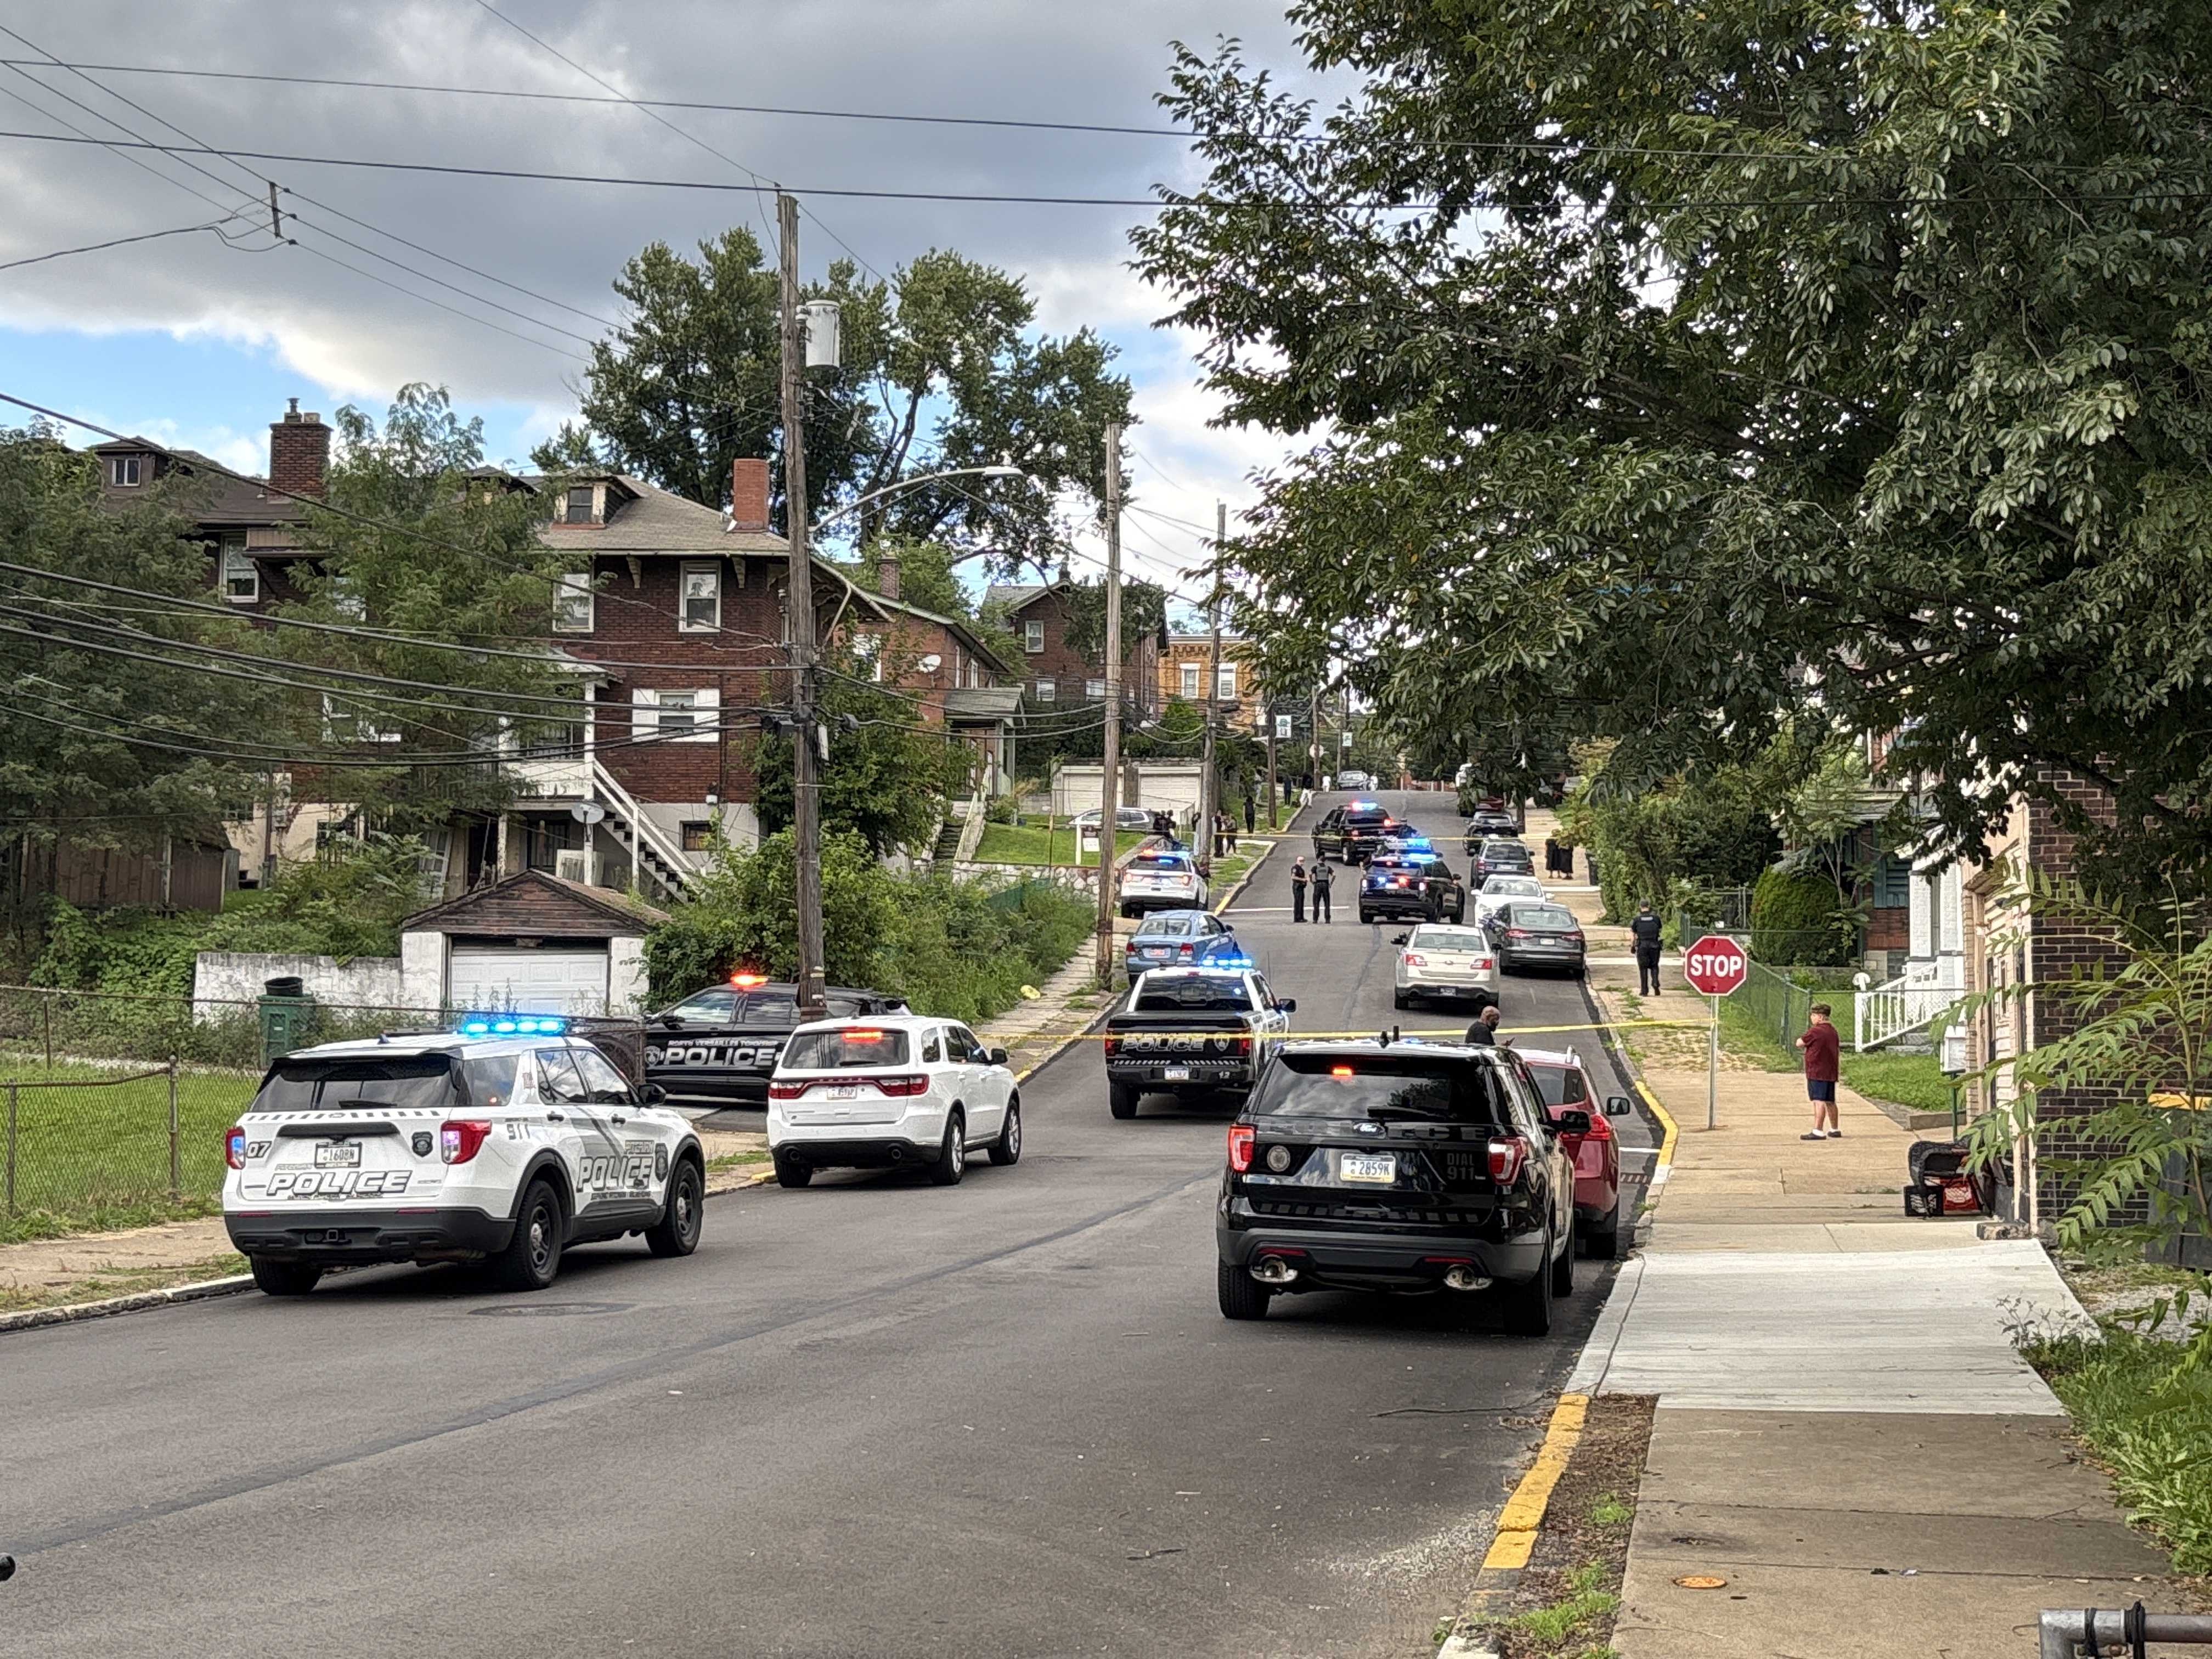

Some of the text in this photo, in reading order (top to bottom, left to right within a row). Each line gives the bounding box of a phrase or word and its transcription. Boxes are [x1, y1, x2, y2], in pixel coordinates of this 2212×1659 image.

[1690, 953, 1742, 978] STOP
[1121, 1032, 1206, 1052] POLICE
[663, 1047, 776, 1066] POLICE
[506, 1124, 531, 1140] 911
[246, 1141, 272, 1159] 07
[1447, 1153, 1475, 1166] DIAL
[576, 1155, 654, 1193] POLICE
[1447, 1166, 1475, 1181] 911
[267, 1170, 413, 1197] POLICE
